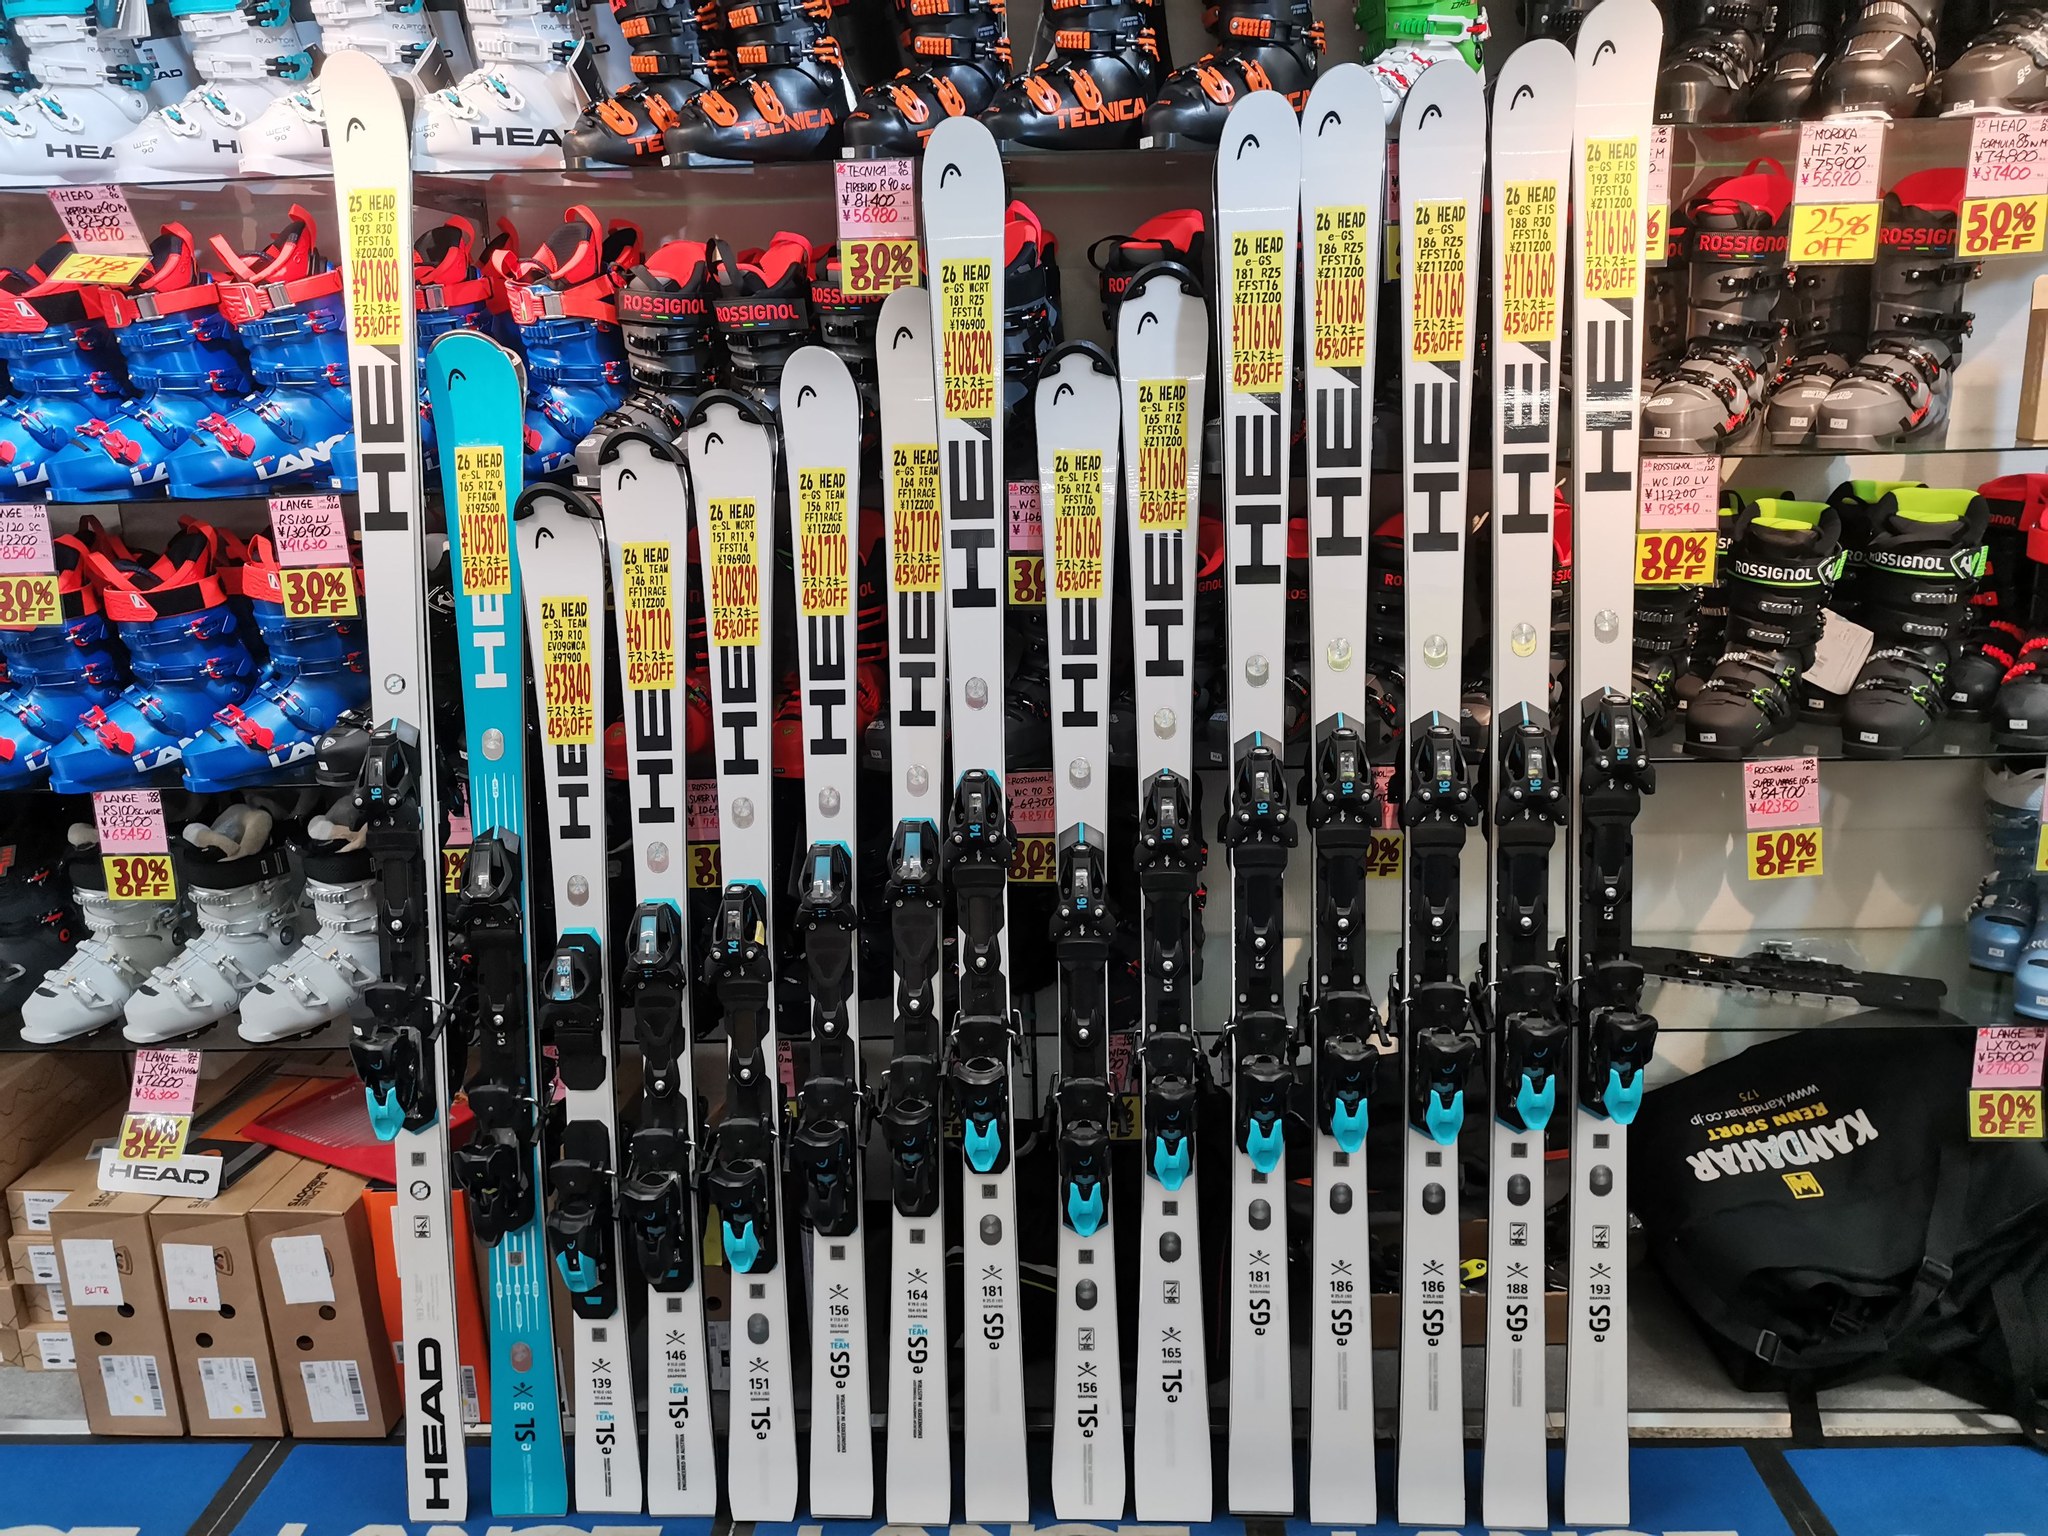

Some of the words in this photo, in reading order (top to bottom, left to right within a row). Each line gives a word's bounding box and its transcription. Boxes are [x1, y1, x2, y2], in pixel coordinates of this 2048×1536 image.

[1988, 119, 2026, 132] HEAD
[470, 127, 570, 147] HEA
[1608, 144, 1636, 160] HEAD
[848, 165, 886, 178] TECNICA
[1618, 161, 1635, 171] FIS
[60, 191, 94, 202] HEAD
[1506, 188, 1520, 206] 26
[1528, 186, 1555, 202] HEAD
[1594, 186, 1628, 196] FFST16
[370, 195, 394, 210] HEAD
[1337, 212, 1365, 229] HEAD
[1437, 206, 1465, 222] HEAD
[1510, 218, 1527, 228] 188
[1534, 217, 1551, 228] R30
[1806, 208, 1872, 237] 25%
[1966, 201, 2038, 239] 50%
[1428, 224, 1454, 235] e-GS
[1587, 210, 1636, 255] ¥116160
[358, 236, 390, 246] FFST16
[1234, 238, 1248, 256] 26
[1256, 237, 1283, 254] HEAD
[1318, 244, 1336, 254] 186
[1343, 243, 1362, 254] R25
[1804, 237, 1858, 256] OFF
[1966, 233, 2035, 252] OFF
[850, 243, 912, 276] 30%
[1246, 256, 1272, 266] e-GS
[1417, 260, 1463, 272] ¥211200
[353, 259, 398, 302] ¥91080
[942, 266, 956, 283] 26
[964, 265, 990, 280] HEAD
[1505, 253, 1554, 298] ¥116160
[1586, 268, 1635, 292] 45%OFF
[850, 275, 913, 291] OFF
[1239, 280, 1278, 290] FFST16
[1315, 278, 1364, 324] ¥116160
[1414, 272, 1464, 318] ¥116160
[354, 304, 400, 315] テストスキー
[623, 295, 708, 314] ROSSIGNOL
[716, 304, 798, 322] ROSSIGNOL
[952, 308, 982, 318] FFST14
[355, 316, 400, 337] 55%OFF
[1233, 304, 1282, 350] ¥116160
[1414, 320, 1463, 331] テストスキー
[944, 330, 992, 376] ¥108290
[1315, 337, 1364, 360] 45%OFF
[946, 388, 993, 412] 45%OFF
[1160, 386, 1186, 400] HEAD
[1144, 414, 1160, 424] 165
[1165, 414, 1181, 424] R12
[477, 452, 502, 468] HEAD
[914, 450, 939, 464] HEAD
[486, 470, 500, 479] PRO
[896, 467, 914, 476] e-GS
[920, 466, 938, 476] TEAM
[1140, 448, 1186, 490] ¥116160
[1652, 462, 1692, 472] ROSSIGNOL
[800, 474, 812, 490] 26
[820, 474, 846, 488] HEAD
[1059, 472, 1078, 482] e-SL
[1084, 472, 1098, 482] FIS
[280, 500, 314, 512] LANGE
[466, 503, 500, 514] ¥192500
[730, 504, 754, 519] HEAD
[807, 501, 820, 511] 156
[826, 501, 840, 511] R17
[1062, 506, 1096, 516] ¥211200
[1140, 502, 1186, 522] 45%OFF
[462, 514, 506, 556] ¥105870
[894, 510, 940, 552] ¥61710
[1056, 516, 1101, 558] ¥116160
[718, 554, 751, 564] ¥196900
[802, 534, 846, 576] ¥61710
[1642, 536, 1708, 568] 30%
[625, 565, 644, 574] e-SL
[650, 564, 668, 573] TEAM
[1056, 560, 1101, 570] テストスキー
[1640, 566, 1705, 580] OFF
[1735, 560, 1814, 580] ROSSIGNOL
[464, 566, 508, 589] 45%OFF
[895, 564, 940, 586] 45%OFF
[287, 572, 346, 602] 30%
[629, 586, 666, 596] FF11RACE
[712, 565, 758, 607] ¥108290
[290, 599, 348, 614] OFF
[542, 603, 554, 620] 26
[562, 602, 587, 618] HEAD
[714, 608, 758, 618] テストスキー
[550, 630, 564, 640] 139
[568, 630, 582, 640] R10
[626, 608, 671, 652] ¥61710
[629, 662, 674, 684] 45%OFF
[545, 662, 591, 705] ¥53840
[1617, 747, 1629, 761] 16
[371, 787, 382, 800] 16
[1343, 781, 1354, 796] 16
[104, 794, 138, 804] LANGE
[1756, 832, 1816, 864] 50%
[112, 858, 168, 886] 30%
[1756, 858, 1816, 876] OFF
[116, 884, 169, 896] OFF
[1739, 1089, 1759, 1102] 175
[1690, 1084, 1820, 1127] www.kandahar.co.jp
[1979, 1094, 2036, 1121] 50%
[1772, 1102, 1829, 1127] RENN
[1707, 1119, 1769, 1141] SPORT
[1980, 1119, 2036, 1134] OFF
[1685, 1108, 1879, 1182] KANDAHAR
[109, 1163, 210, 1185] HEAD
[982, 1286, 1002, 1296] 181
[1330, 1280, 1353, 1292] 186
[1422, 1280, 1444, 1292] 186
[1506, 1284, 1528, 1294] 188
[1590, 1284, 1610, 1294] 193
[907, 1290, 928, 1300] 164
[829, 1305, 849, 1316] 156
[1249, 1298, 1270, 1336] eGS
[984, 1313, 1004, 1350] eGS
[1331, 1308, 1352, 1346] eGS
[1506, 1304, 1528, 1342] eGS
[1589, 1304, 1610, 1342] eGS
[666, 1350, 686, 1360] 146
[908, 1336, 928, 1374] eGS
[1161, 1348, 1181, 1358] 165
[830, 1351, 850, 1389] eGS
[592, 1378, 612, 1388] 139
[749, 1378, 769, 1390] 151
[1162, 1369, 1182, 1403] eSL
[514, 1402, 534, 1412] PRO
[416, 1337, 450, 1509] HEAD
[751, 1406, 771, 1440] eSL
[1077, 1404, 1098, 1438] eSL
[514, 1418, 536, 1452] eSL
[596, 1422, 616, 1454] eSL
